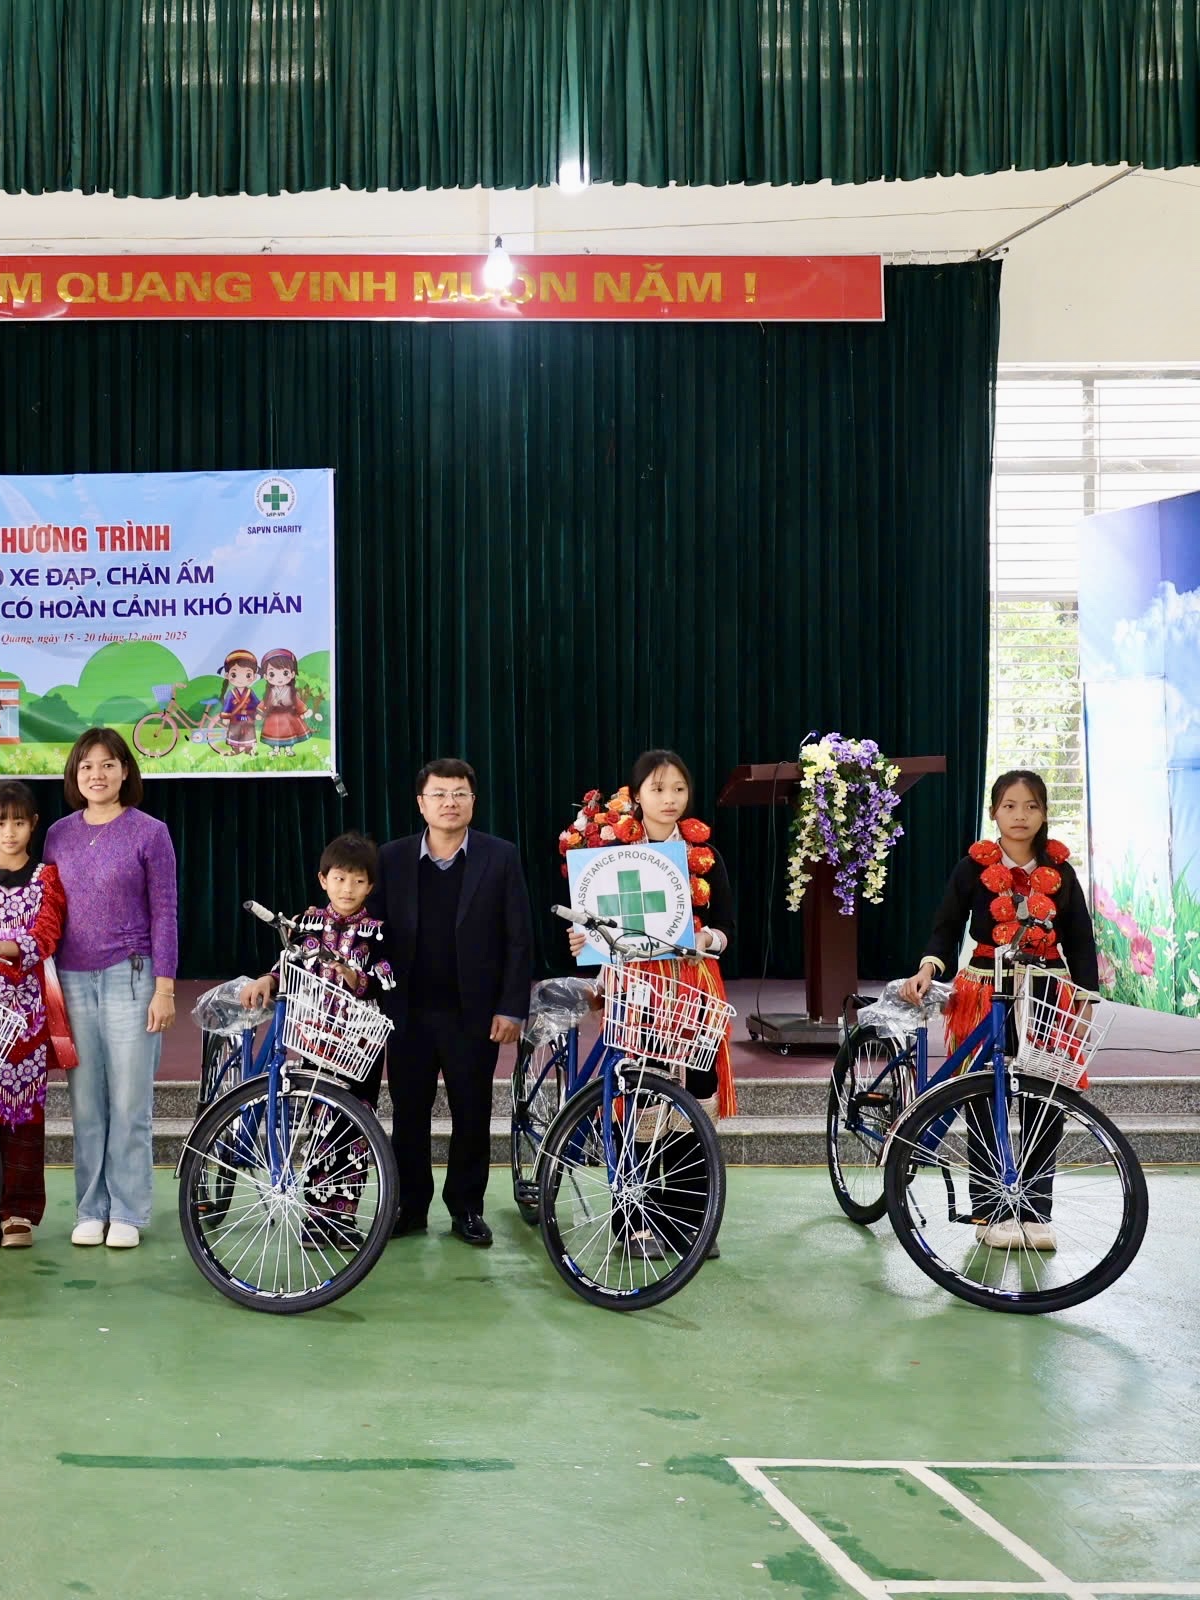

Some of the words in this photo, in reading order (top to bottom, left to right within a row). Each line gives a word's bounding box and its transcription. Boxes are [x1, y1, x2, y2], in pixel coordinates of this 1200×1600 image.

[56, 271, 251, 303] QUANG
[271, 271, 397, 301] VINH
[594, 263, 721, 301] NĂM
[745, 272, 757, 303] !
[96, 520, 170, 552] TRÌNH
[247, 526, 271, 534] SAPVN
[273, 525, 302, 534] CHARITY
[9, 568, 40, 587] XE
[45, 567, 101, 590] ĐẠP,
[106, 562, 171, 586] CHĂN
[176, 558, 215, 584] ẤM
[1, 596, 34, 619] CÓ
[39, 595, 106, 619] HOÀN
[112, 594, 177, 618] CẢNH
[183, 593, 233, 617] KHÓ
[238, 591, 303, 615] KHĂN
[37, 632, 60, 644] ngày
[63, 634, 74, 643] 15
[84, 633, 96, 642] 20
[165, 631, 188, 641] 2025
[617, 851, 669, 872] PROGRAM
[578, 853, 616, 906] ASSISTANCE
[666, 870, 682, 892] FOR
[665, 893, 685, 938] VIETNAM
